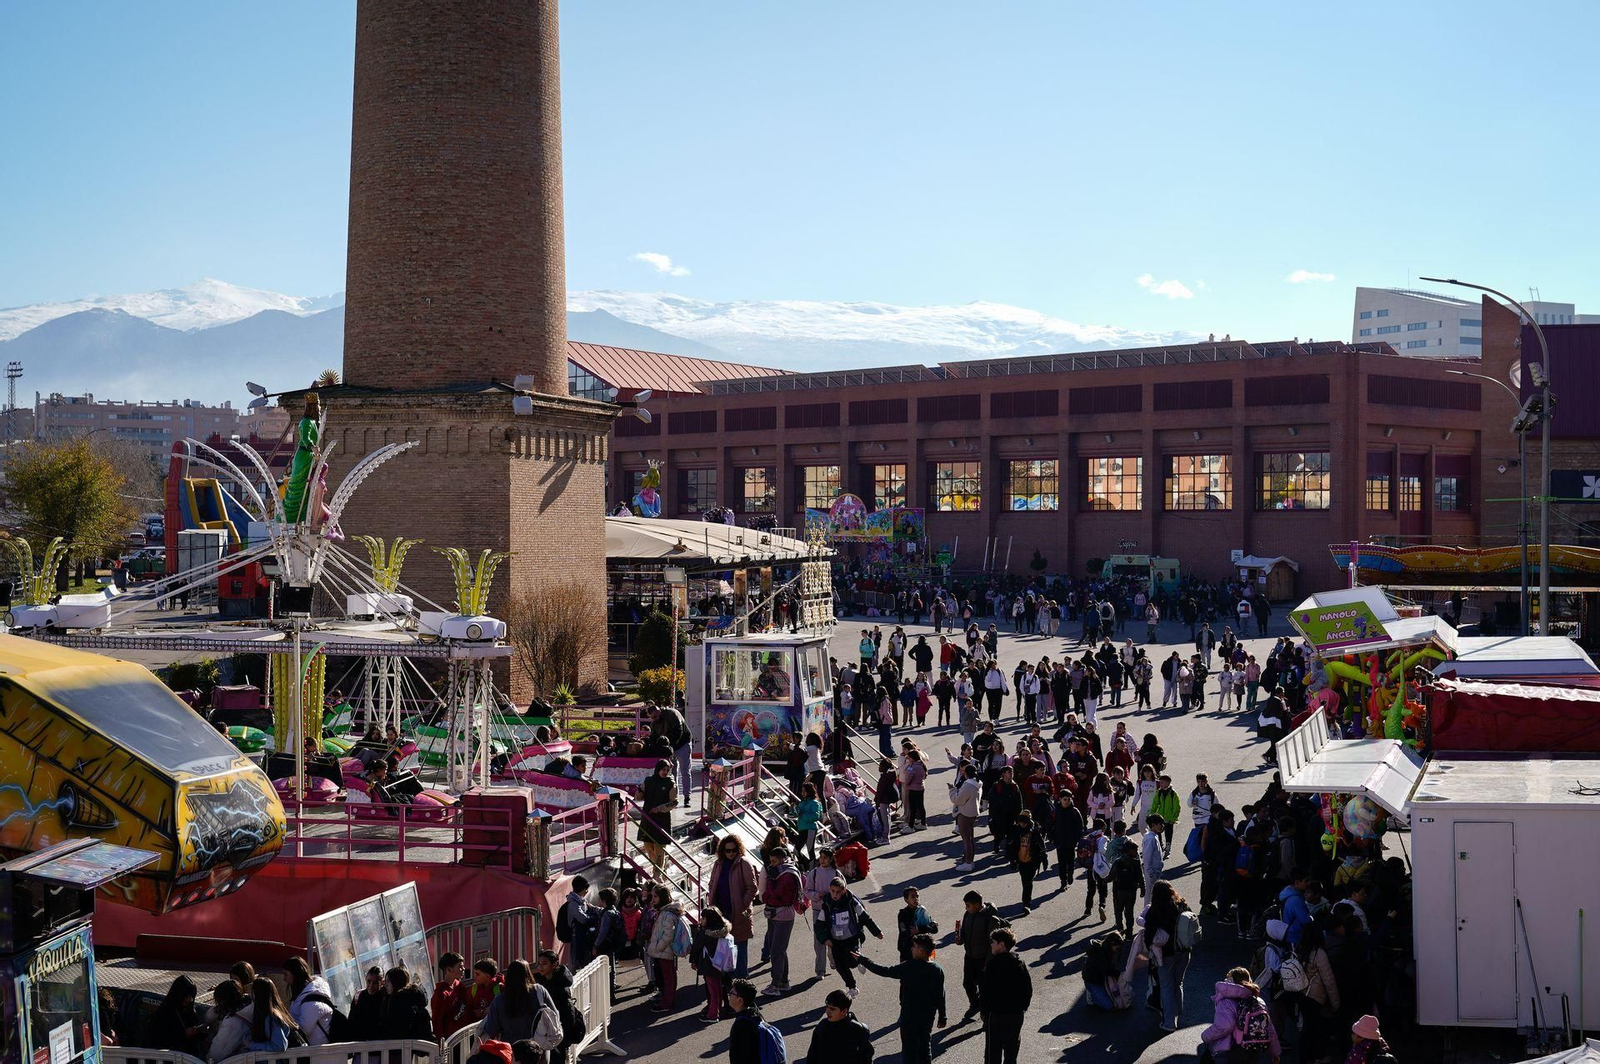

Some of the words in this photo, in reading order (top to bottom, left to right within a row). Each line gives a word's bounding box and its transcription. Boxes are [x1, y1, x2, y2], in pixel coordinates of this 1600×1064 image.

[1319, 610, 1357, 622] MANOLO
[190, 762, 226, 775] SPACE
[26, 935, 84, 984] TAQUILLA
